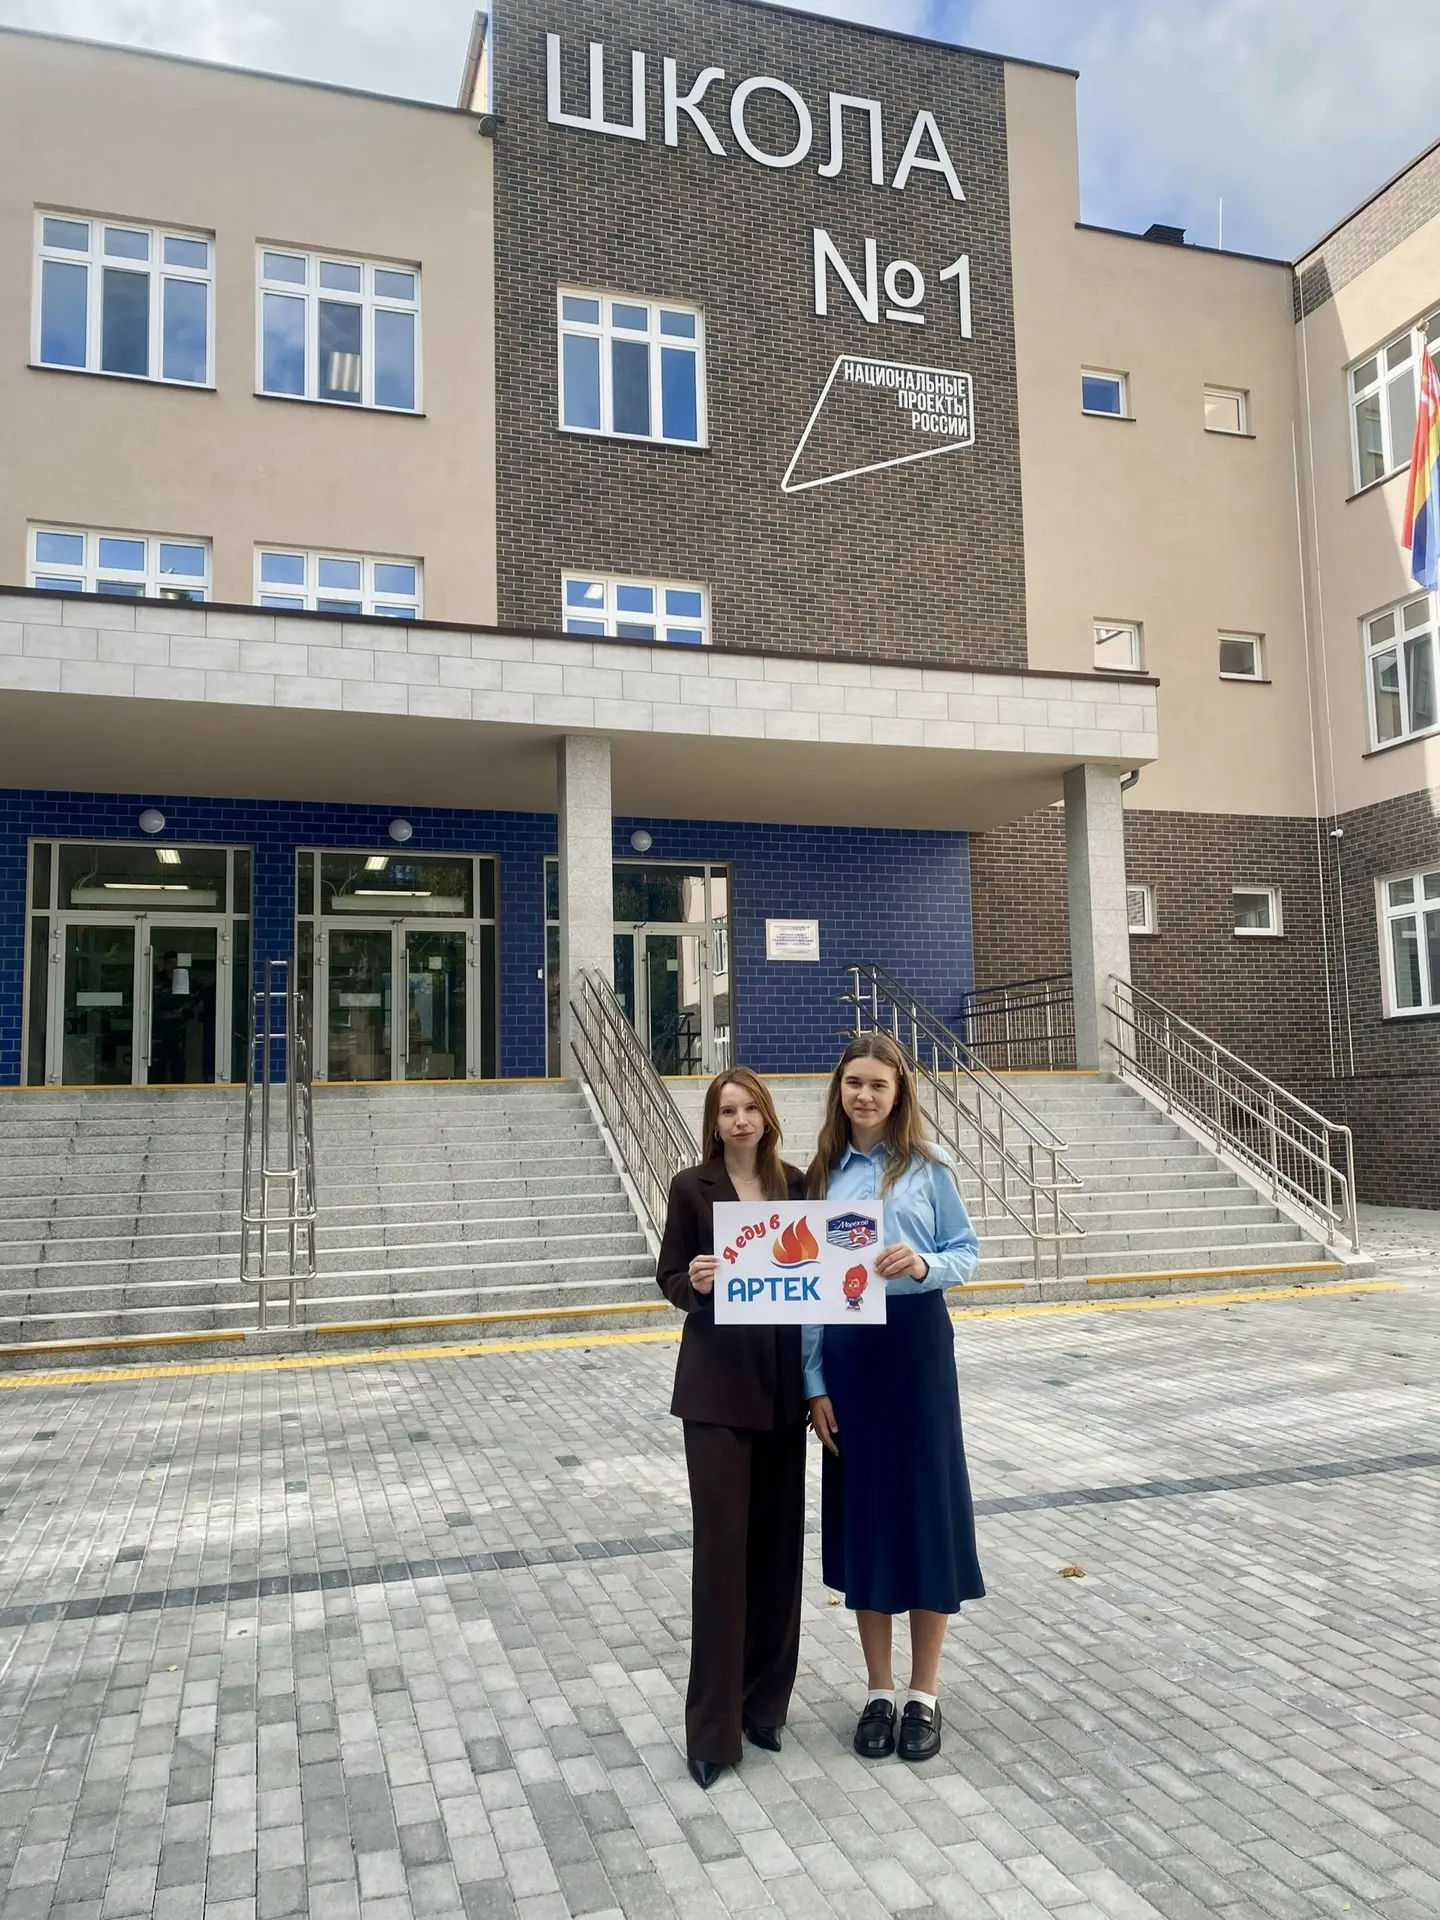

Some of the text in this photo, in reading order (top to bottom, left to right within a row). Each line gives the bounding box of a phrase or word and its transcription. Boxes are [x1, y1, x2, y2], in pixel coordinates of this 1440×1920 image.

[546, 33, 967, 201] ШКОЛА
[844, 361, 967, 397] НАЦИОНАЛЬНЫЕ
[898, 390, 967, 417] ПРОЕКТЫ
[911, 411, 968, 437] РОССИИ
[723, 1215, 780, 1264] Я еду в
[728, 1277, 821, 1302] АРТЕК
